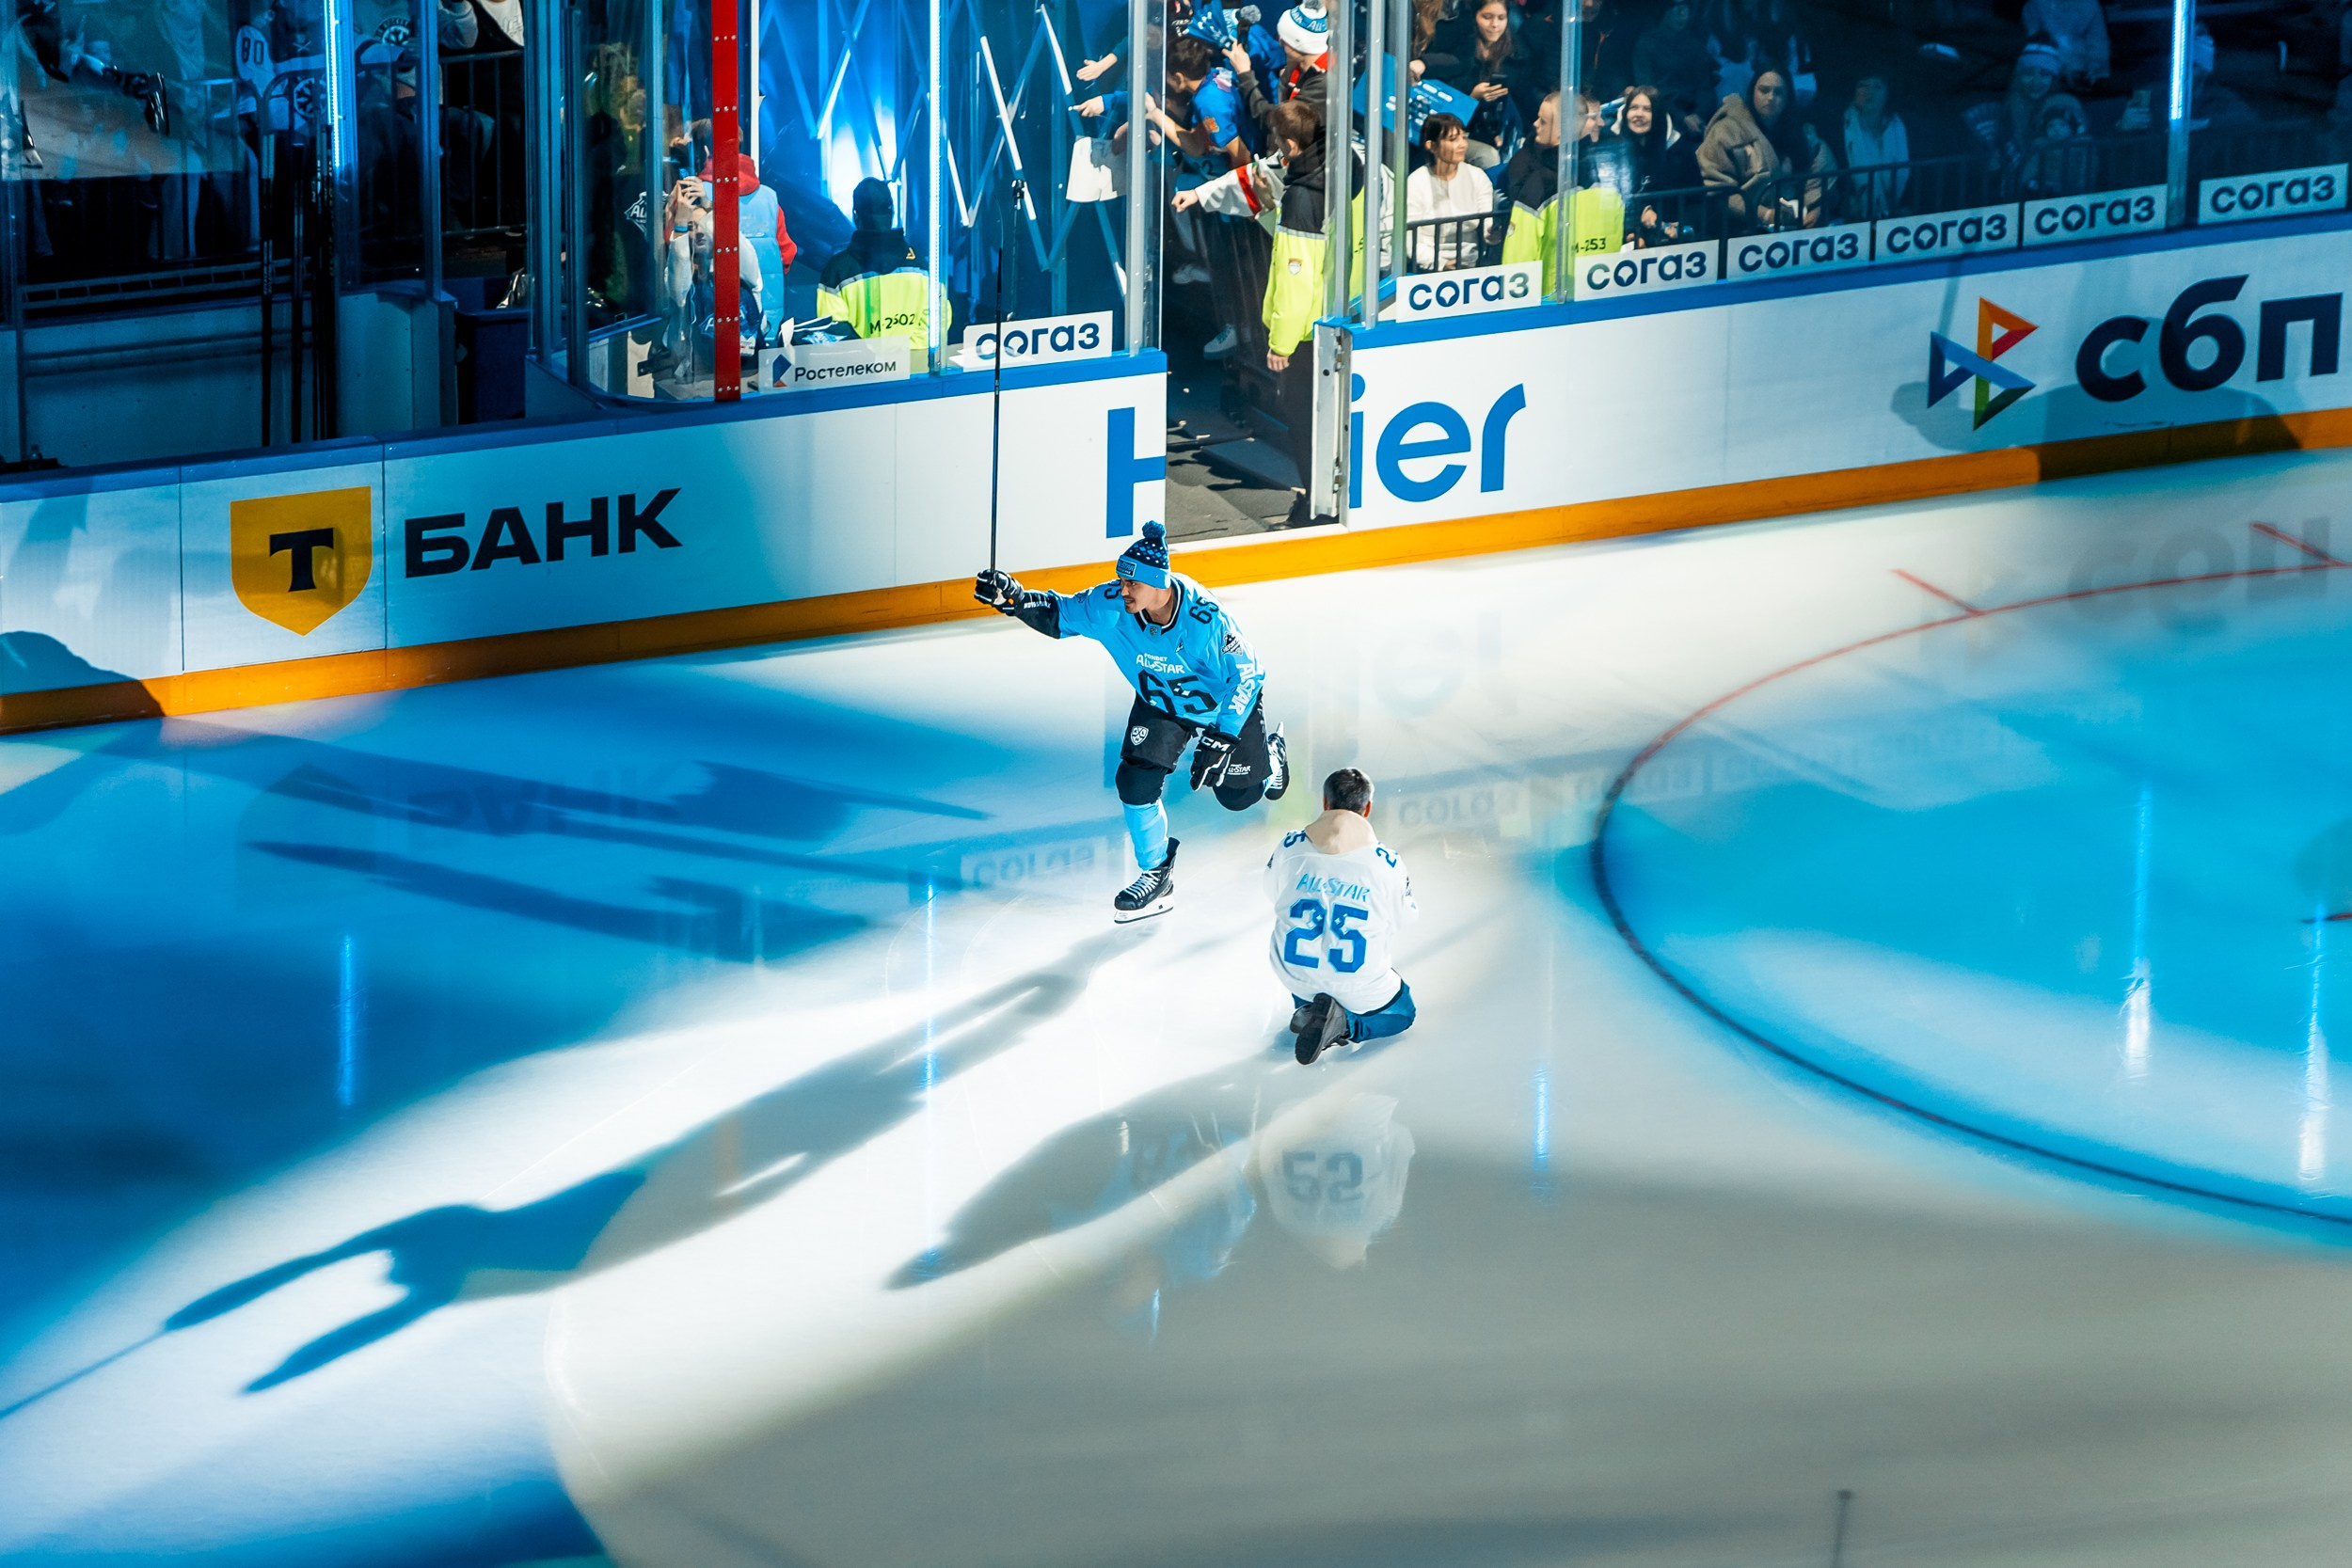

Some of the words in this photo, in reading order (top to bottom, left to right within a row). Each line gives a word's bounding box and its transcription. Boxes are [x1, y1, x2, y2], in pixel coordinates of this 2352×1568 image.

[242, 37, 264, 65] 80
[2212, 175, 2335, 214] согаз
[1887, 214, 2007, 254] согаз
[2035, 196, 2155, 235] согаз
[1586, 250, 1707, 291] согаз
[1739, 232, 1859, 273] согаз
[1408, 272, 1530, 311] согаз
[976, 322, 1100, 360] согаз
[2074, 274, 2343, 403] сбп
[794, 359, 897, 382] Ростелеком
[405, 487, 683, 578] БАНК
[1189, 596, 1219, 625] 65
[1137, 669, 1220, 716] 65
[1200, 736, 1231, 752] CM
[1283, 898, 1369, 973] 25
